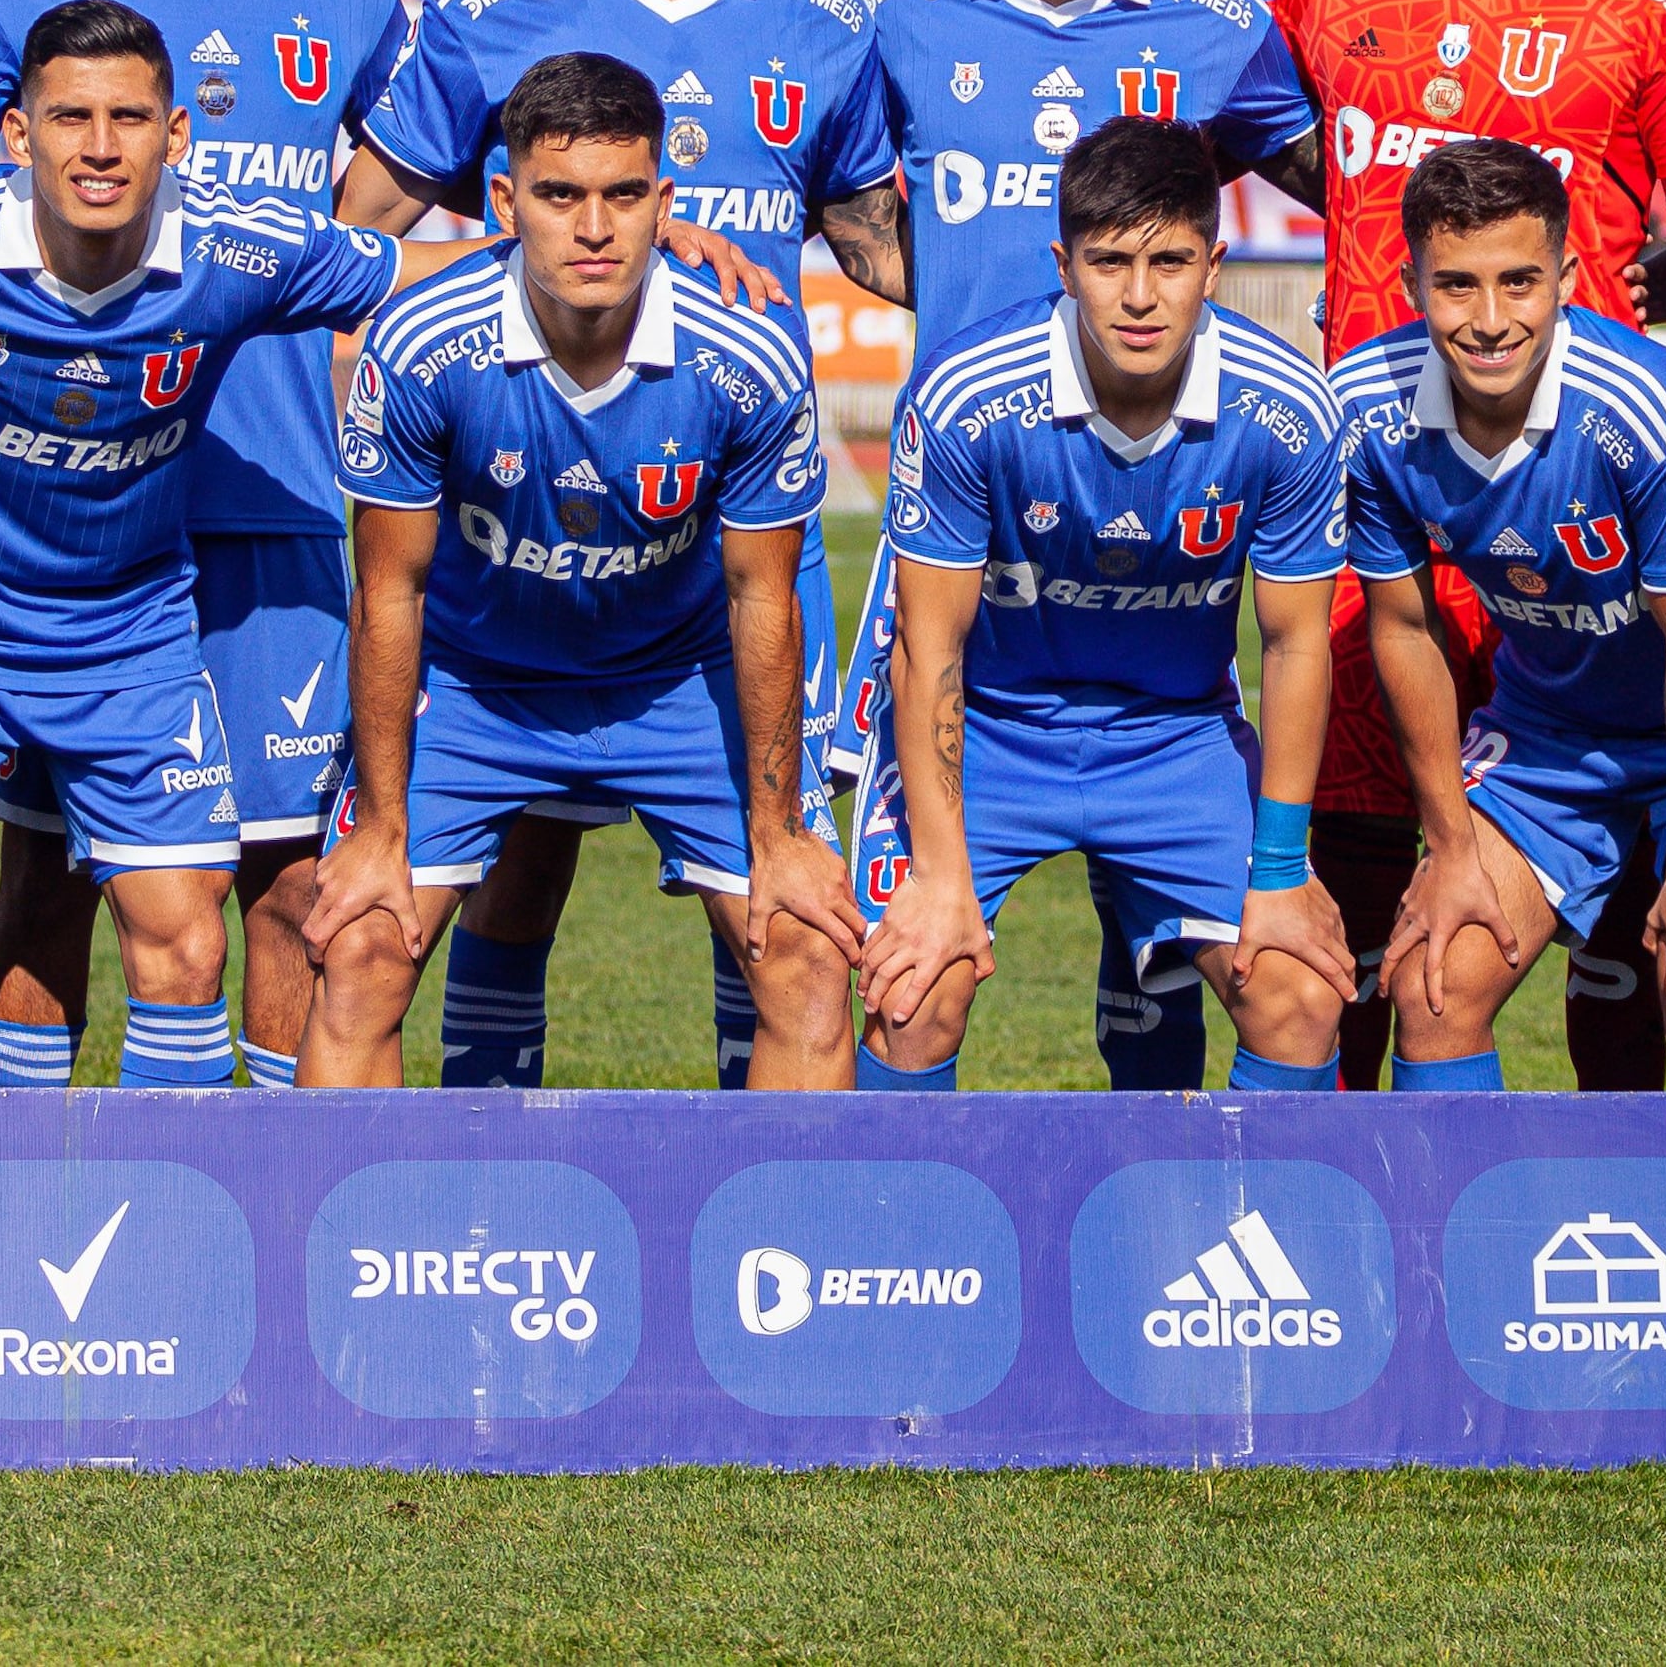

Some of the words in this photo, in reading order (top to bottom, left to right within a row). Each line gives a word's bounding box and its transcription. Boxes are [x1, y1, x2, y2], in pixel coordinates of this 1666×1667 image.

[190, 48, 240, 66] adidas
[273, 33, 331, 105] U
[1343, 41, 1385, 58] adidas
[1498, 27, 1567, 97] U
[662, 88, 713, 106] adidas
[1032, 80, 1084, 98] adidas
[1116, 68, 1181, 122] U
[750, 74, 807, 149] U
[213, 244, 280, 280] MEDS
[222, 235, 277, 258] CLINICA
[411, 318, 499, 387] DIRECTV
[471, 341, 505, 372] GO
[55, 364, 110, 385] adidas
[139, 343, 205, 410] U
[710, 366, 762, 415] MEDS
[957, 378, 1050, 443] DIRECTV
[1252, 405, 1309, 455] MEDS
[1270, 397, 1311, 434] CLINICA
[1383, 412, 1421, 445] GO
[346, 434, 371, 467] PF
[554, 475, 608, 495] adidas
[636, 460, 703, 521] U
[509, 513, 699, 582] BETANO
[1096, 524, 1151, 542] adidas
[1179, 501, 1244, 560] U
[1553, 515, 1629, 576] U
[1042, 576, 1242, 611] BETANO
[264, 730, 346, 761] Rexona
[350, 1249, 597, 1300] DIRECTV
[818, 1266, 983, 1307] BETANO
[509, 1297, 599, 1343] GO
[1142, 1297, 1343, 1349] adidas
